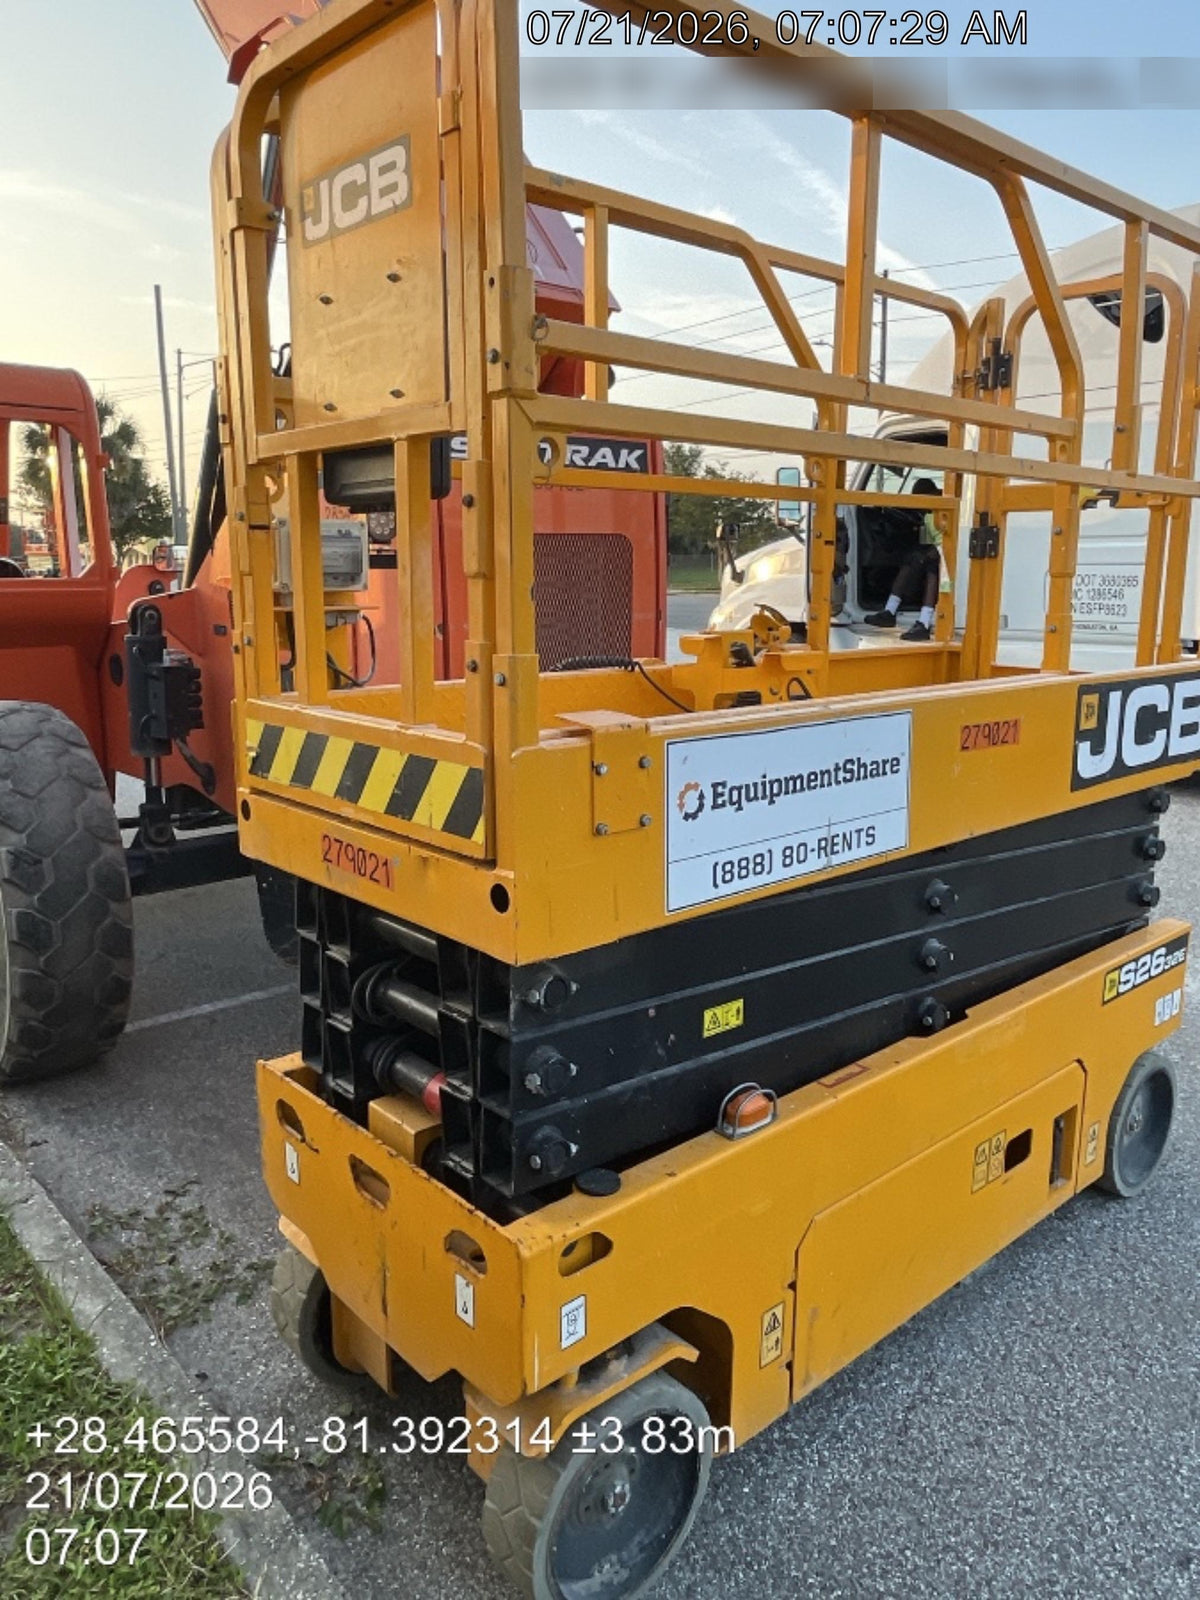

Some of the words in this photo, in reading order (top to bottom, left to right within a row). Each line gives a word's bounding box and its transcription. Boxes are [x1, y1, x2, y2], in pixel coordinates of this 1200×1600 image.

[303, 144, 408, 241] JCB
[961, 719, 1018, 750] 279021
[711, 756, 901, 812] EquipmentShare
[323, 834, 390, 888] 279021
[712, 849, 773, 889] (888)
[781, 825, 876, 868] 80-RENTS
